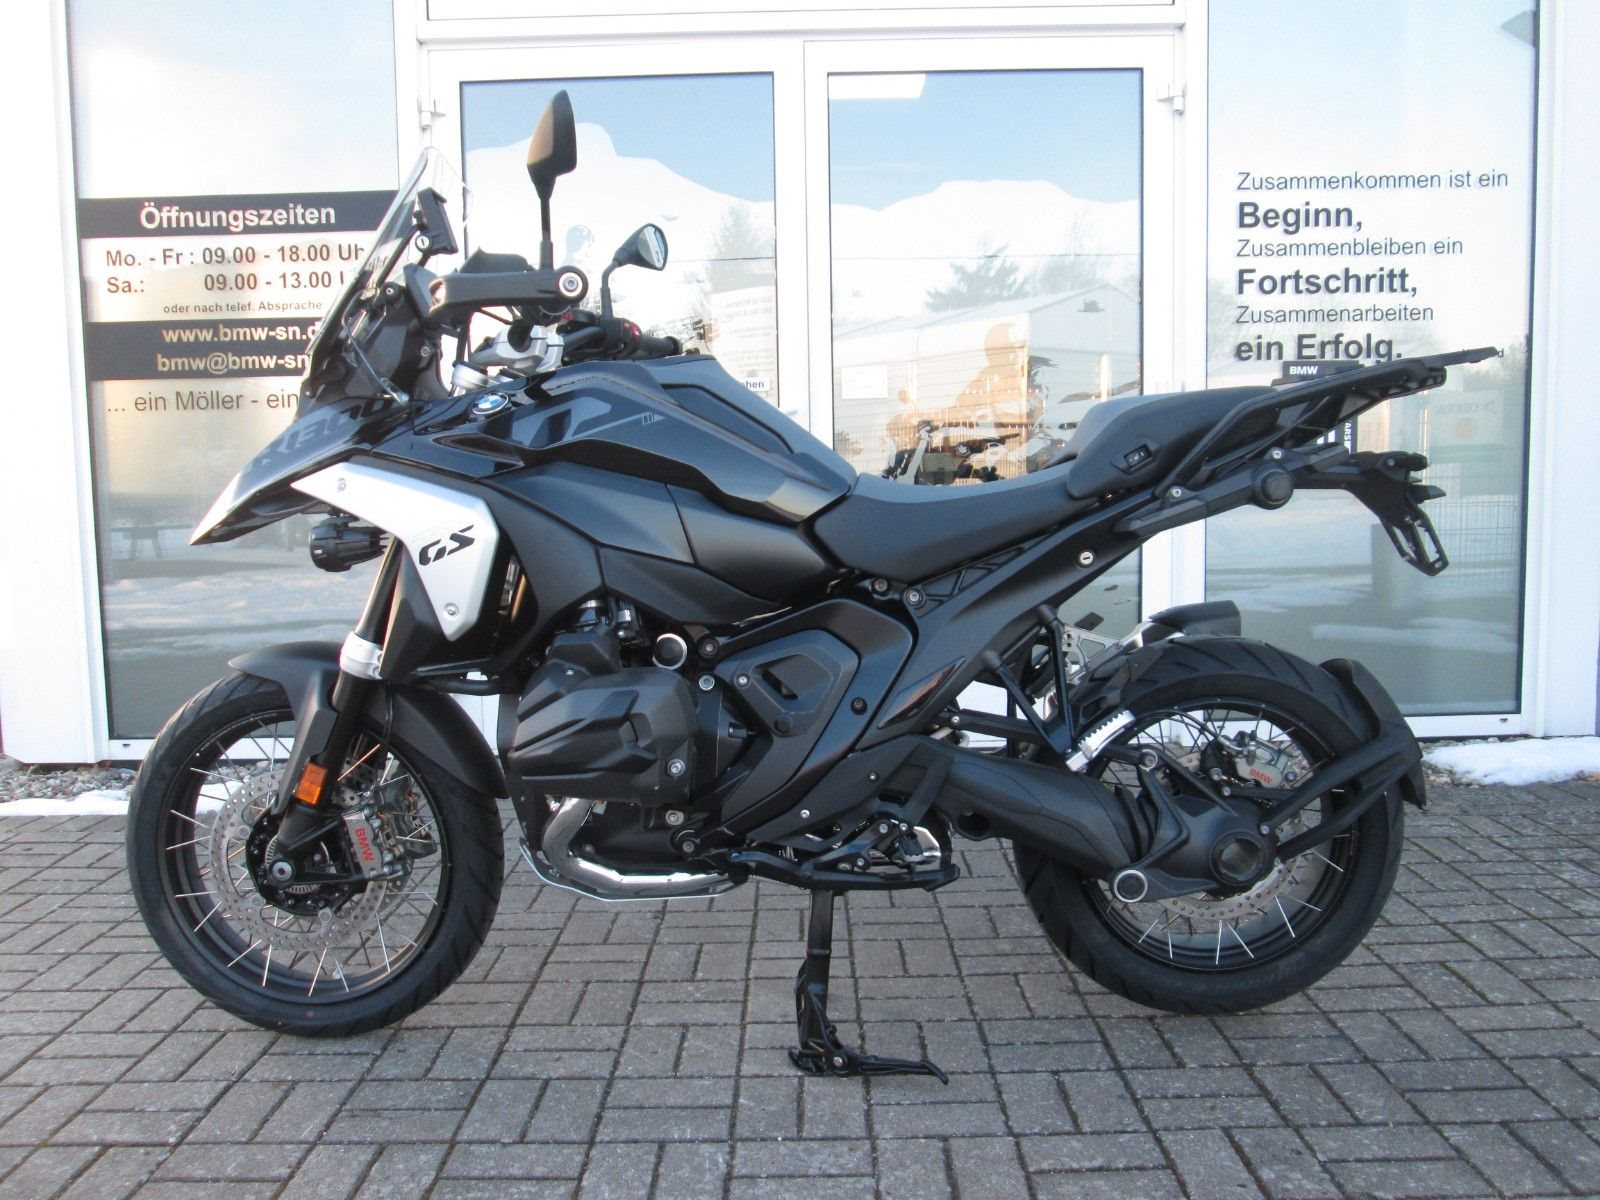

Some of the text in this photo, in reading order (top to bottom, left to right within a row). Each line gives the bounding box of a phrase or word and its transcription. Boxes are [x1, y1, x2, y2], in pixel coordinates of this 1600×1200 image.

[1236, 169, 1509, 191] Zusammenkommen ist ein
[139, 202, 336, 232] Öffnungszeiten
[1238, 201, 1363, 235] Beginn,
[106, 250, 142, 267] Mo.
[202, 247, 256, 265] 09.00
[277, 244, 331, 262] 18.00
[338, 244, 365, 261] Uh
[1236, 237, 1463, 257] Zusammenbleiben ein
[106, 277, 145, 293] Sa.:
[204, 273, 258, 291] 09.00
[279, 271, 332, 289] 13.00
[1238, 266, 1418, 297] Fortschritt,
[163, 300, 322, 314] oder nach telef. Absprache
[1235, 304, 1434, 324] Zusammenarbeiten
[162, 322, 321, 343] www.bmw-sn.d
[1235, 333, 1402, 364] ein Erfolg.
[157, 351, 309, 375] bmw@bmw-sn
[1289, 365, 1318, 376] BMW
[745, 379, 765, 389] hen
[134, 392, 167, 411] ein
[176, 389, 243, 410] Möller
[266, 388, 298, 409] ein
[419, 524, 475, 566] GS
[1248, 767, 1273, 784] BMW
[355, 827, 375, 862] BMW
